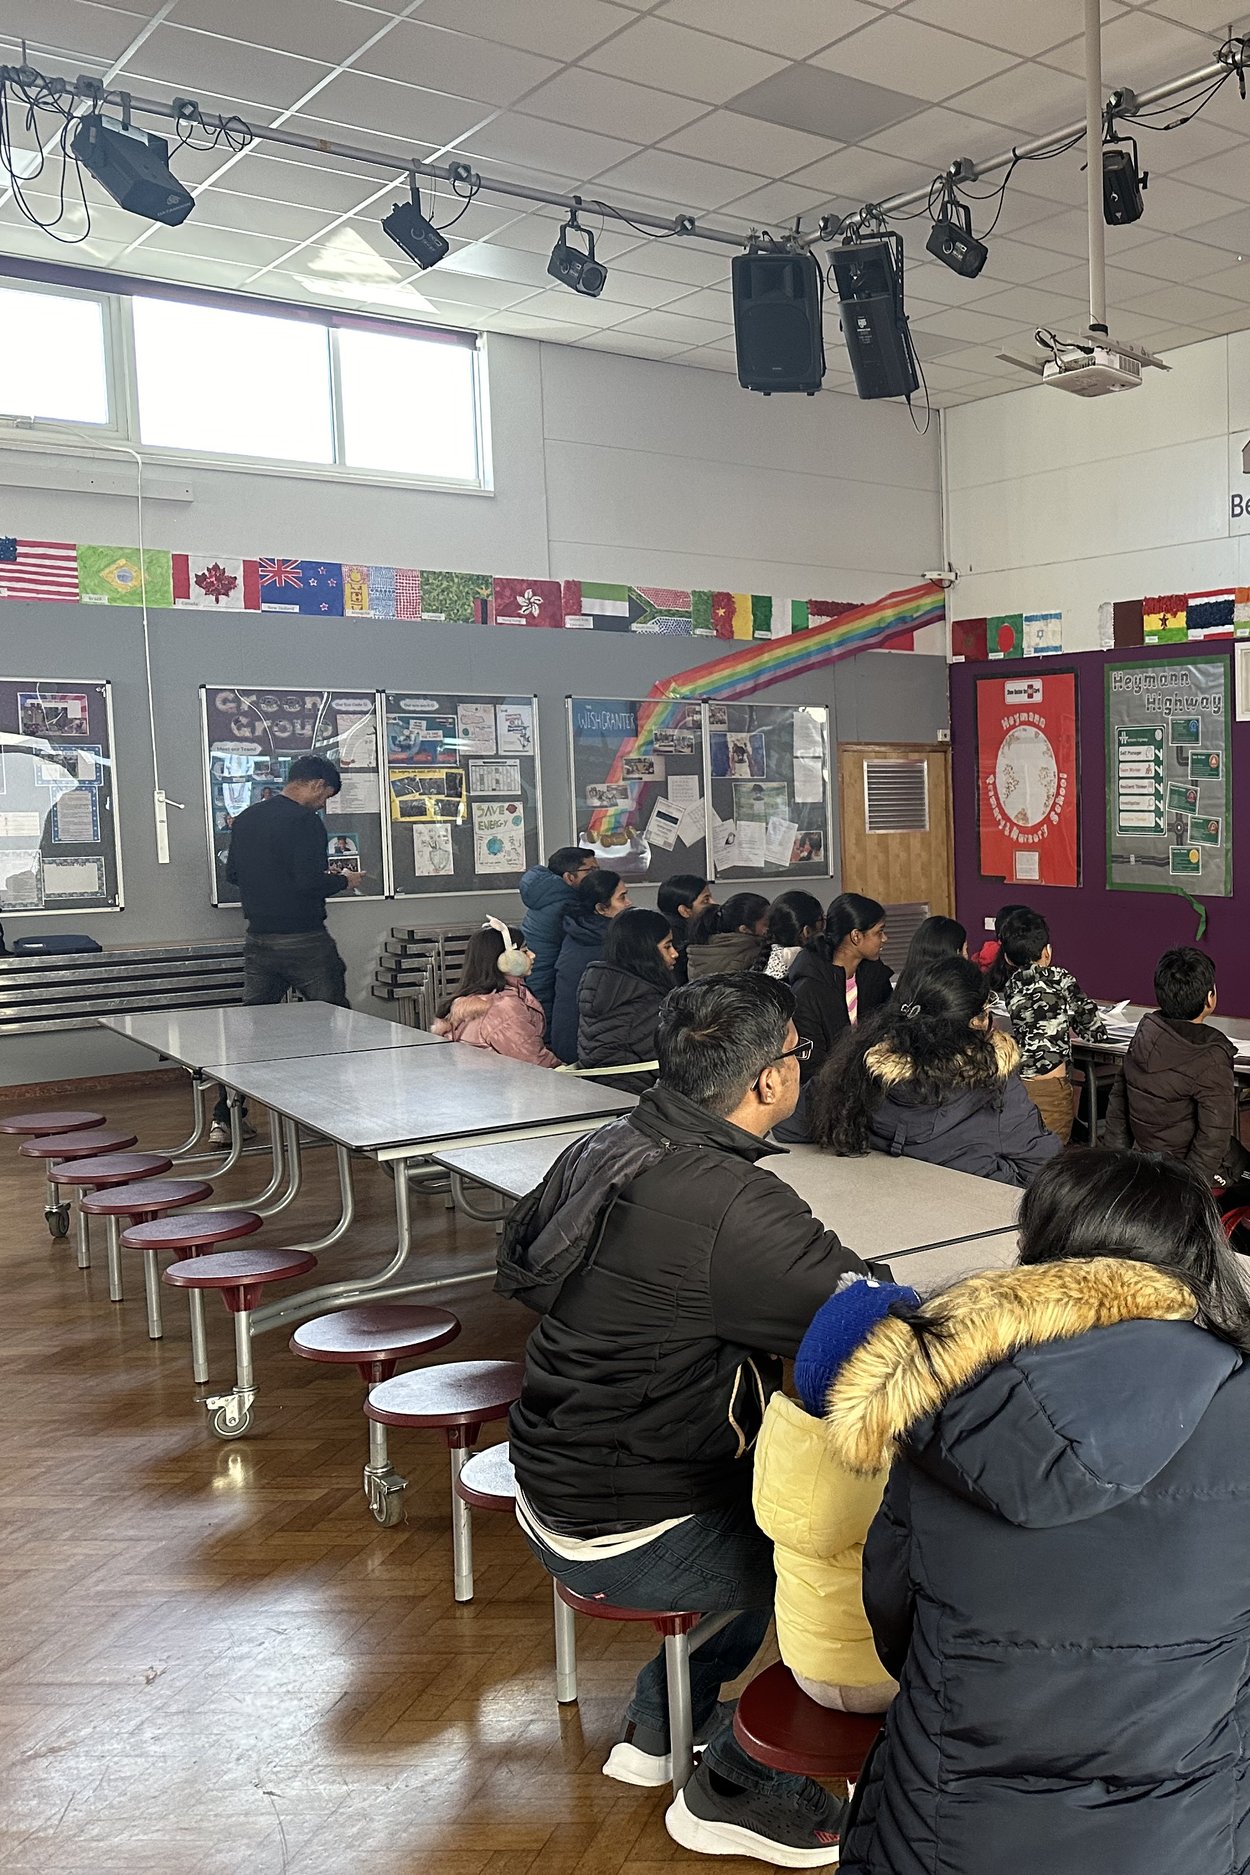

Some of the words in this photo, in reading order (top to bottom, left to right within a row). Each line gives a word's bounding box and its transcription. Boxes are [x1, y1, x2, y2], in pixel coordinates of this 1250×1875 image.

[1111, 670, 1192, 696] Heymann
[215, 691, 324, 713] Green
[1145, 690, 1223, 717] Highway
[231, 715, 333, 740] Group
[1001, 711, 1046, 731] Heymann
[476, 804, 505, 819] SAVE
[985, 773, 1006, 830] Primary
[1010, 824, 1049, 844] Nursery
[1049, 772, 1068, 825] School
[478, 819, 509, 832] ENERGY
